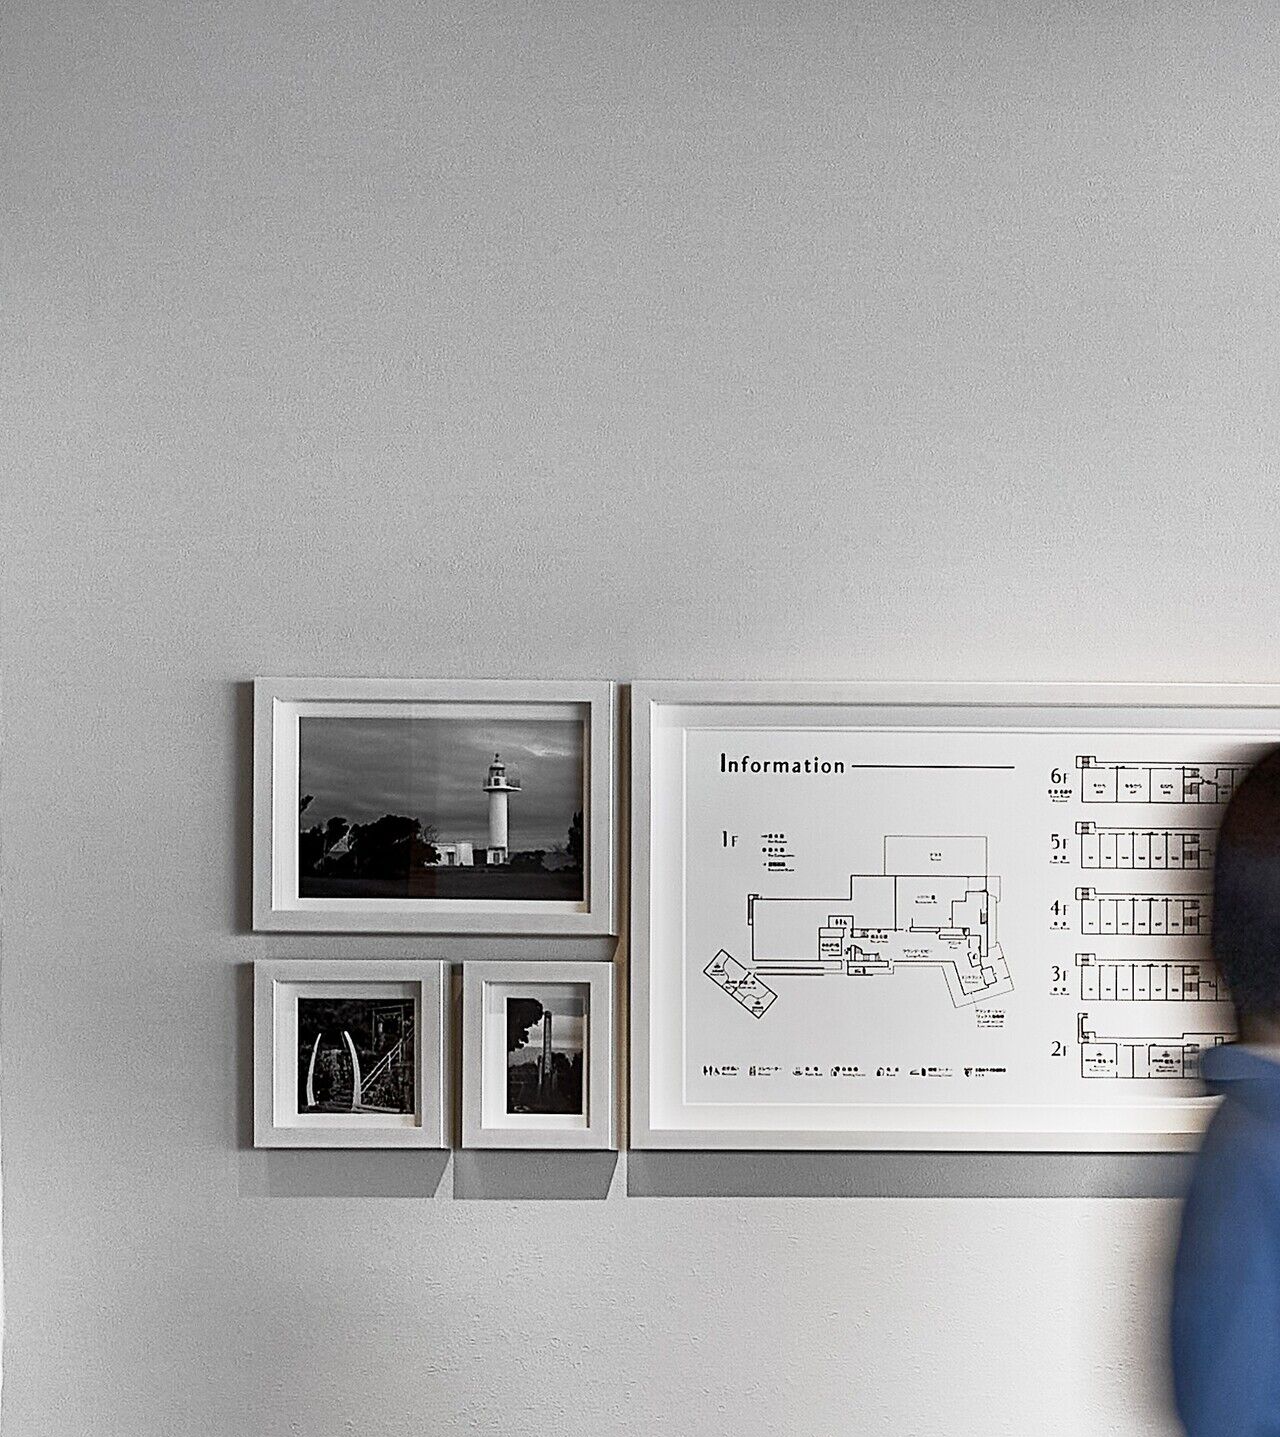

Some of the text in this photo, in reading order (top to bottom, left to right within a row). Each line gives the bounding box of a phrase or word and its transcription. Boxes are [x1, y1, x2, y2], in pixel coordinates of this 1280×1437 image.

[720, 752, 845, 774] Information
[1051, 767, 1070, 784] 6F
[722, 831, 739, 848] 1F
[1051, 834, 1069, 850] 5F
[1050, 899, 1070, 916] 4F
[1052, 965, 1070, 982] 3F
[1051, 1040, 1069, 1057] 2F
